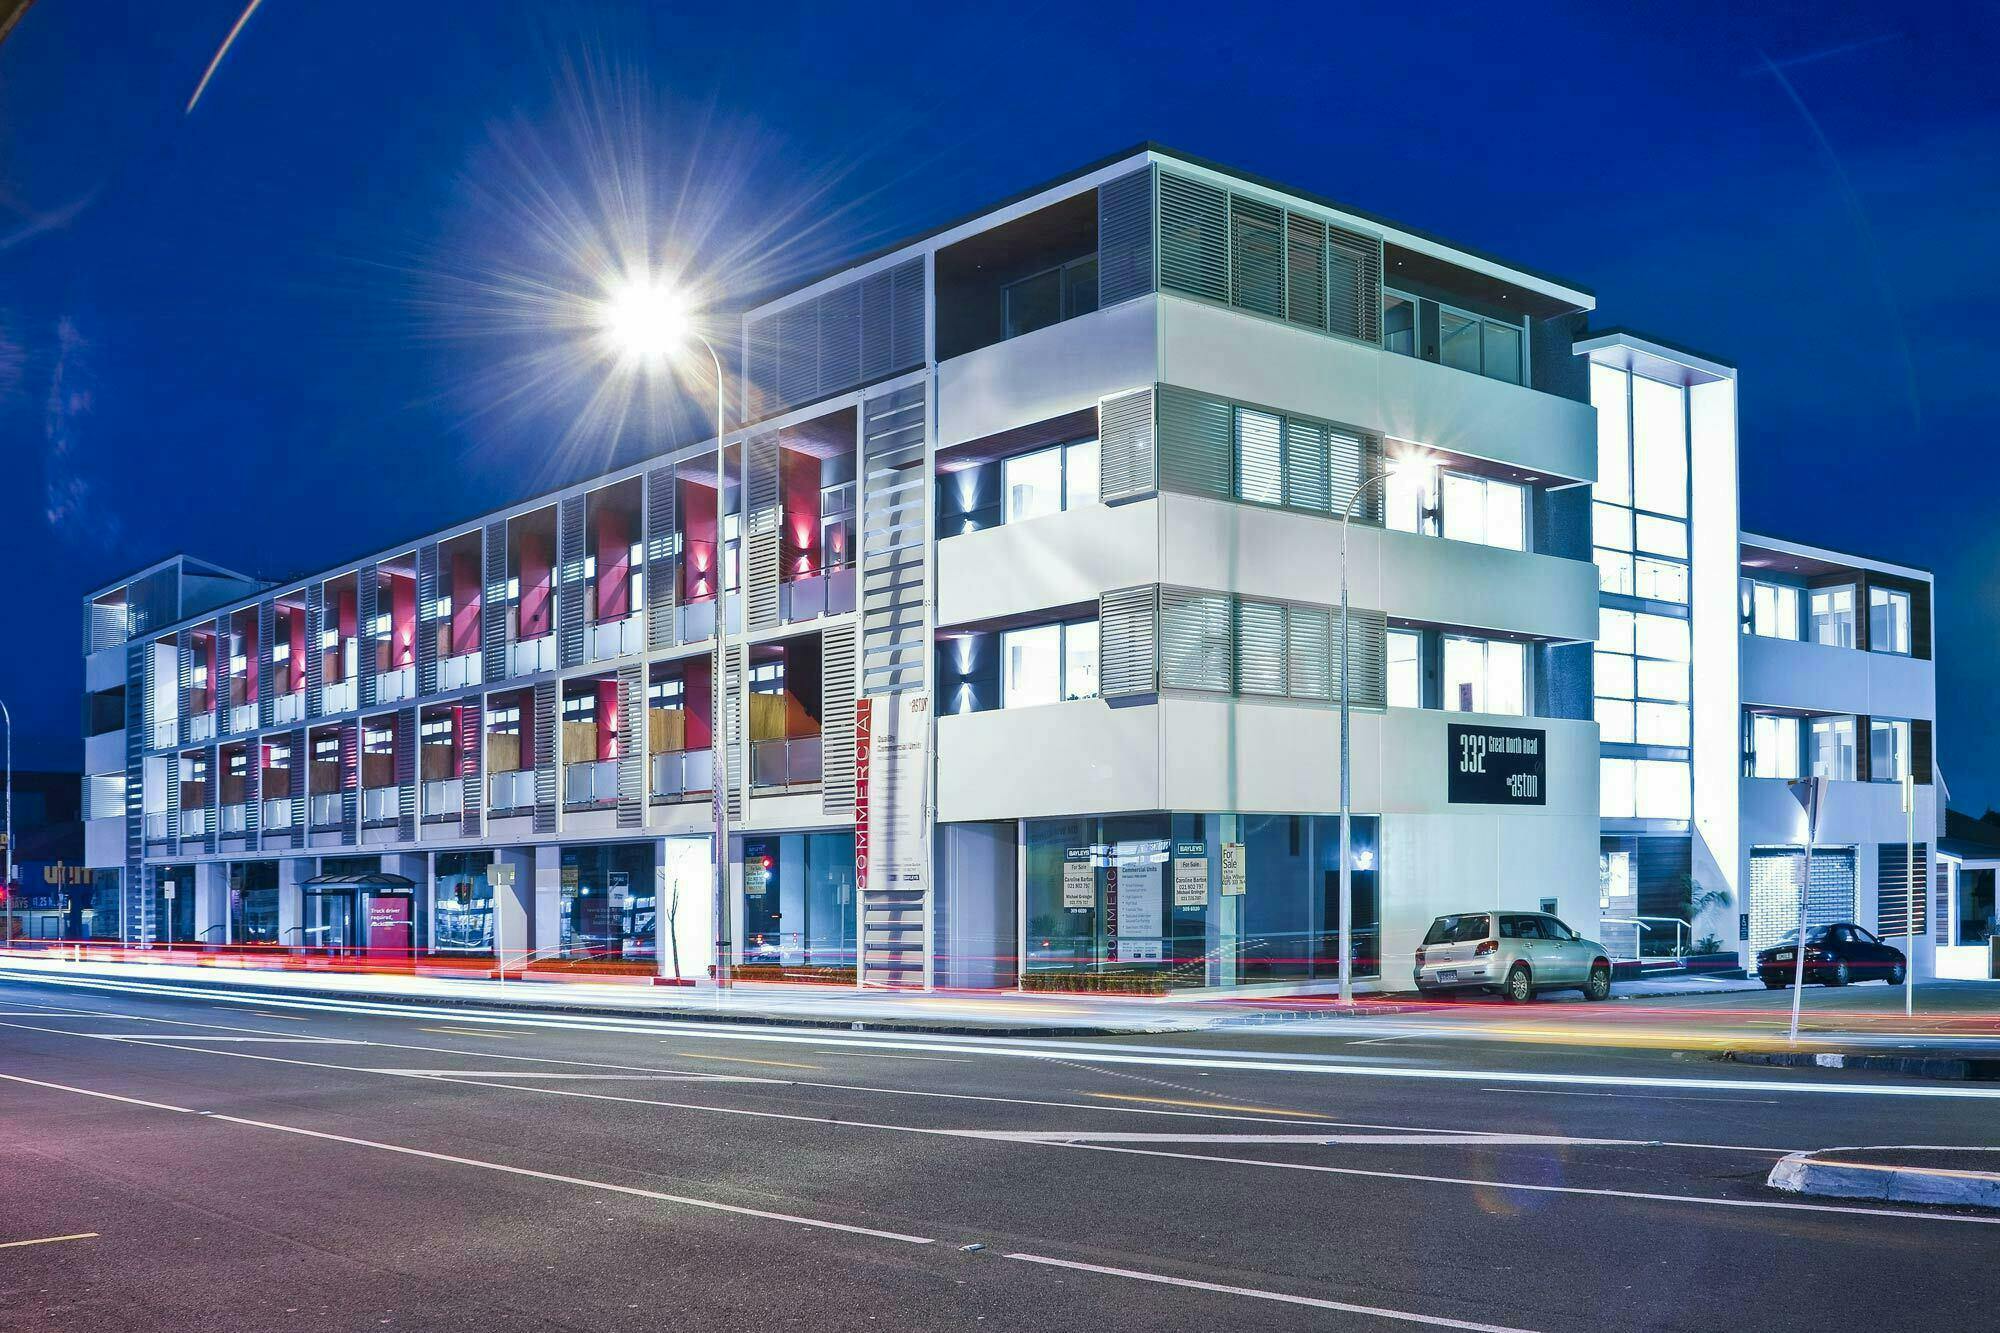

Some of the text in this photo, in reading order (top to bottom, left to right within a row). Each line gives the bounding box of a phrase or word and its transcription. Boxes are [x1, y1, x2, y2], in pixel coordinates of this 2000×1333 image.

[1460, 734, 1538, 773] 332 Great North Road
[856, 698, 872, 890] COMMERCIAL
[1511, 773, 1538, 797] aston
[1223, 850, 1234, 859] For
[1223, 859, 1238, 869] Sale
[1106, 870, 1117, 962] COMMERC
